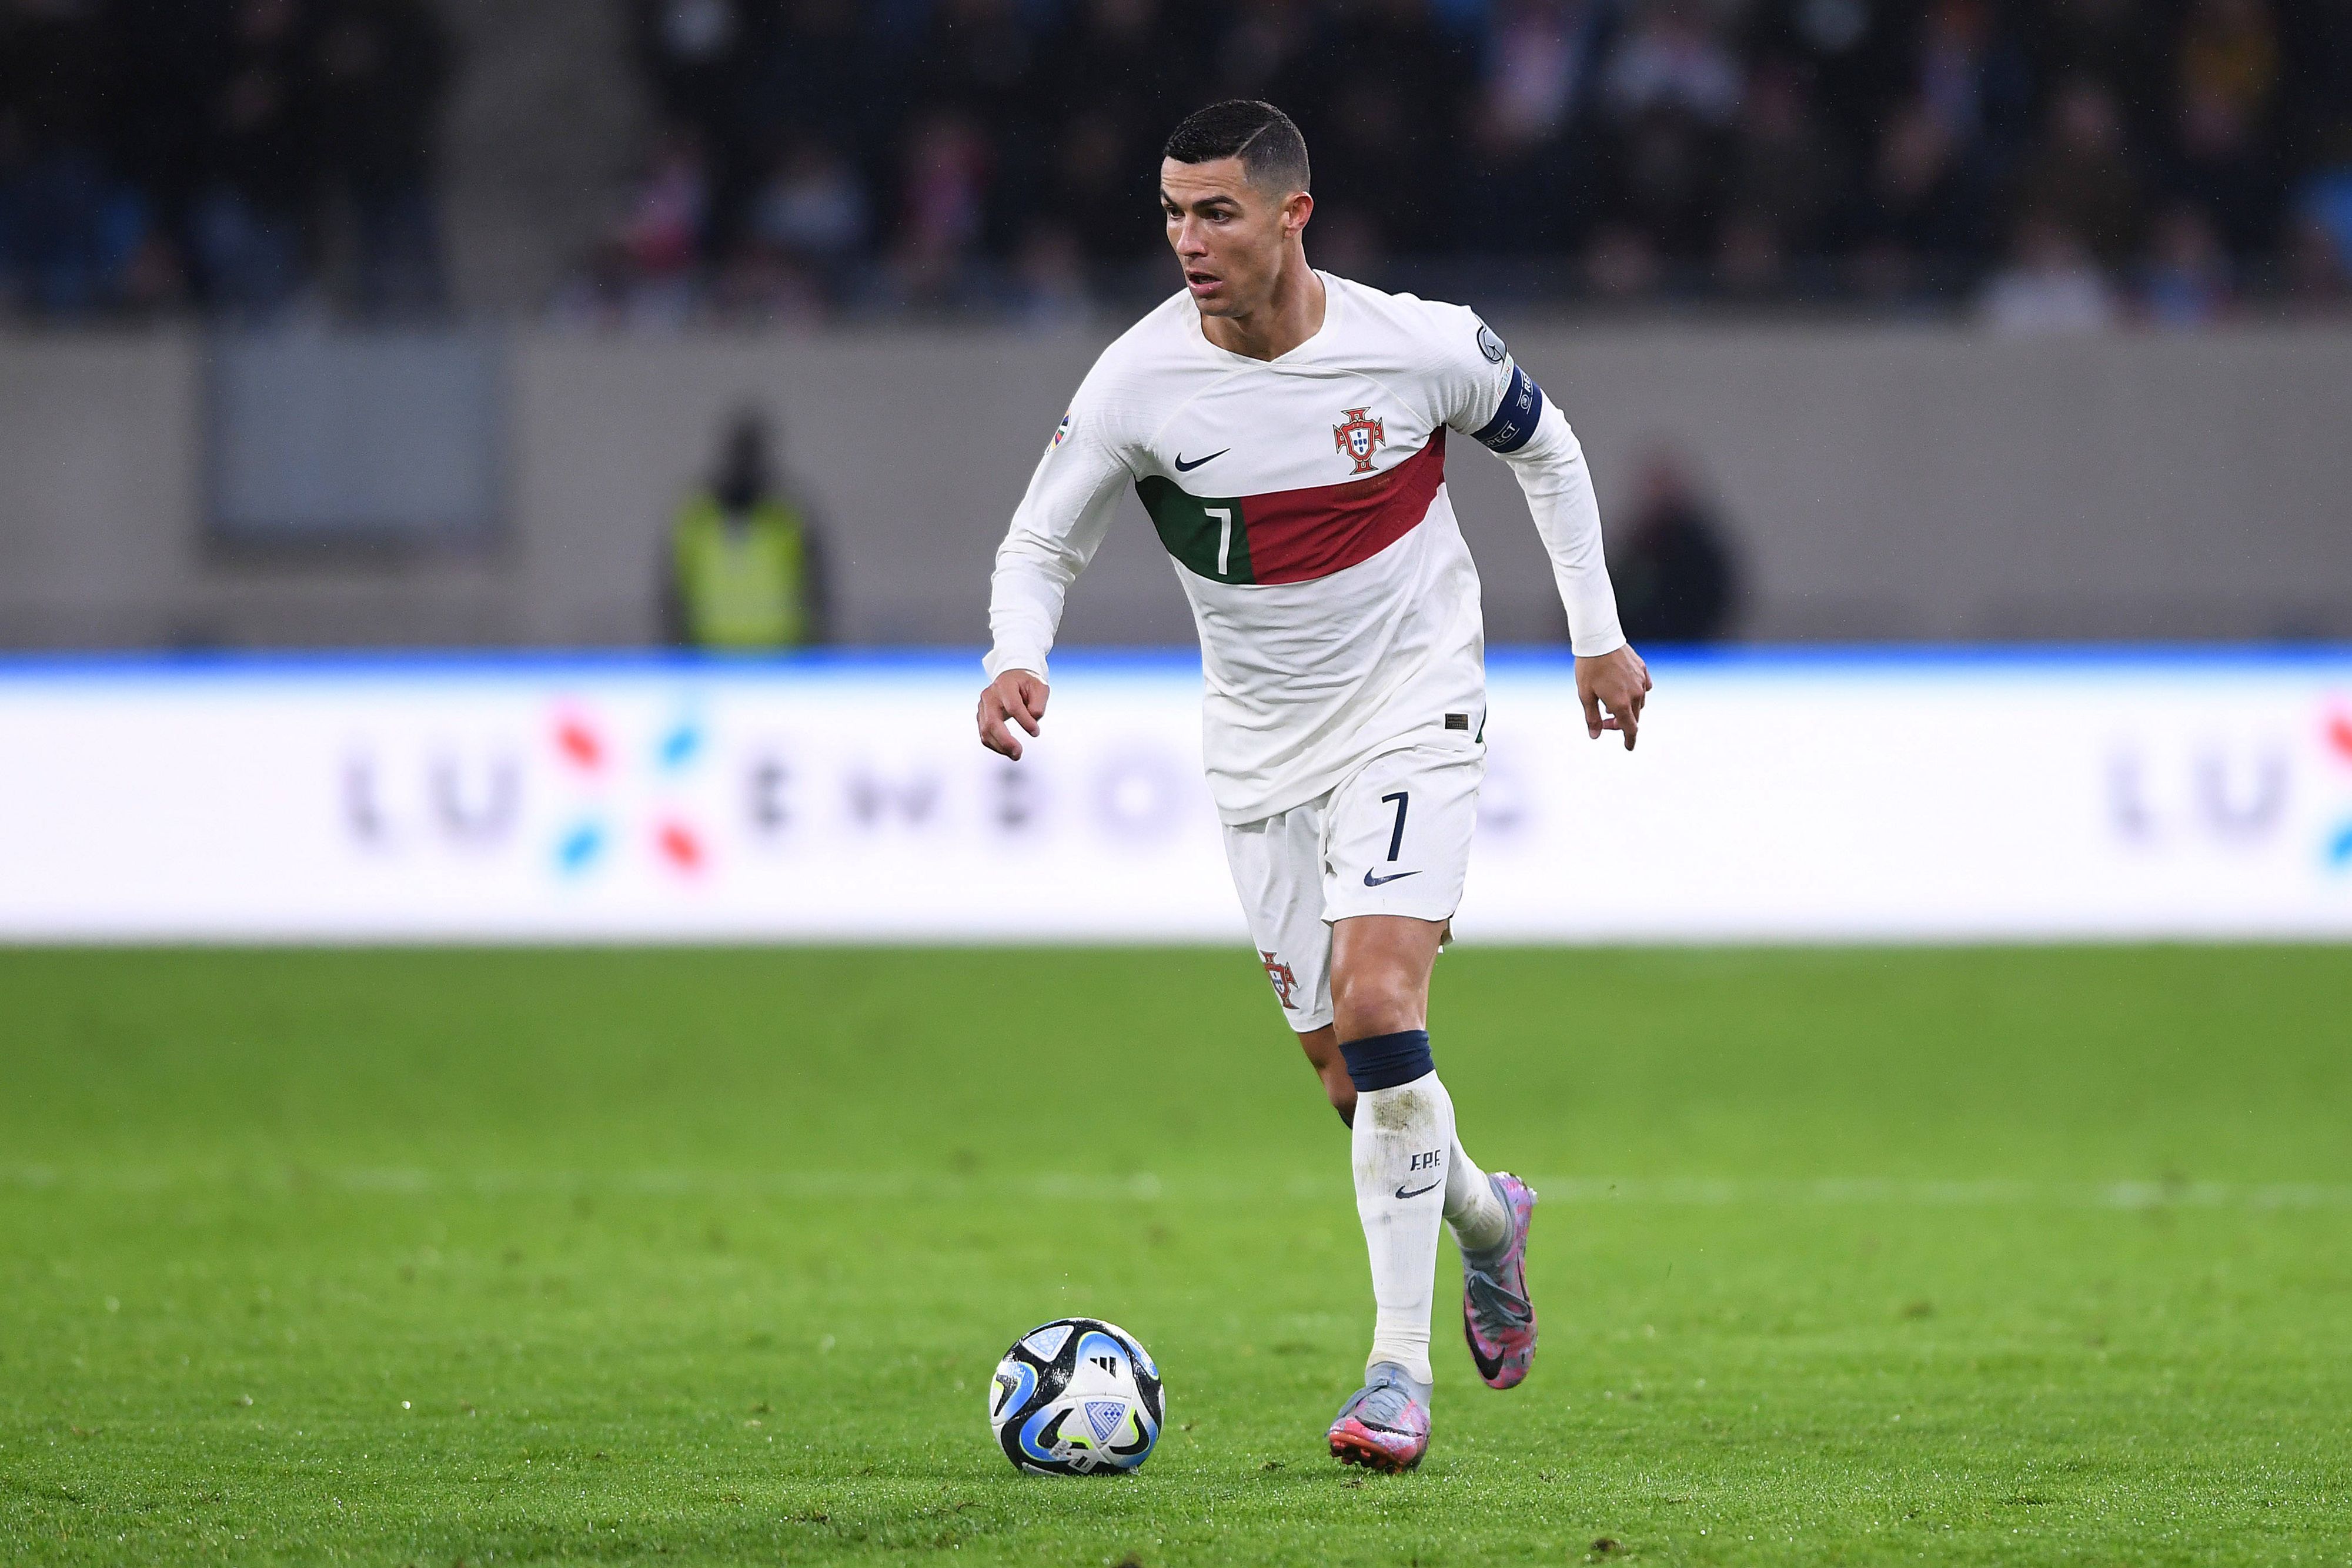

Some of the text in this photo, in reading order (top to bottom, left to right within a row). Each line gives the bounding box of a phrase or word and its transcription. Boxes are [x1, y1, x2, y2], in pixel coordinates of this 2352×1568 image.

[1488, 422, 1515, 446] PECT
[1204, 507, 1231, 575] 7
[1382, 791, 1409, 861] 7
